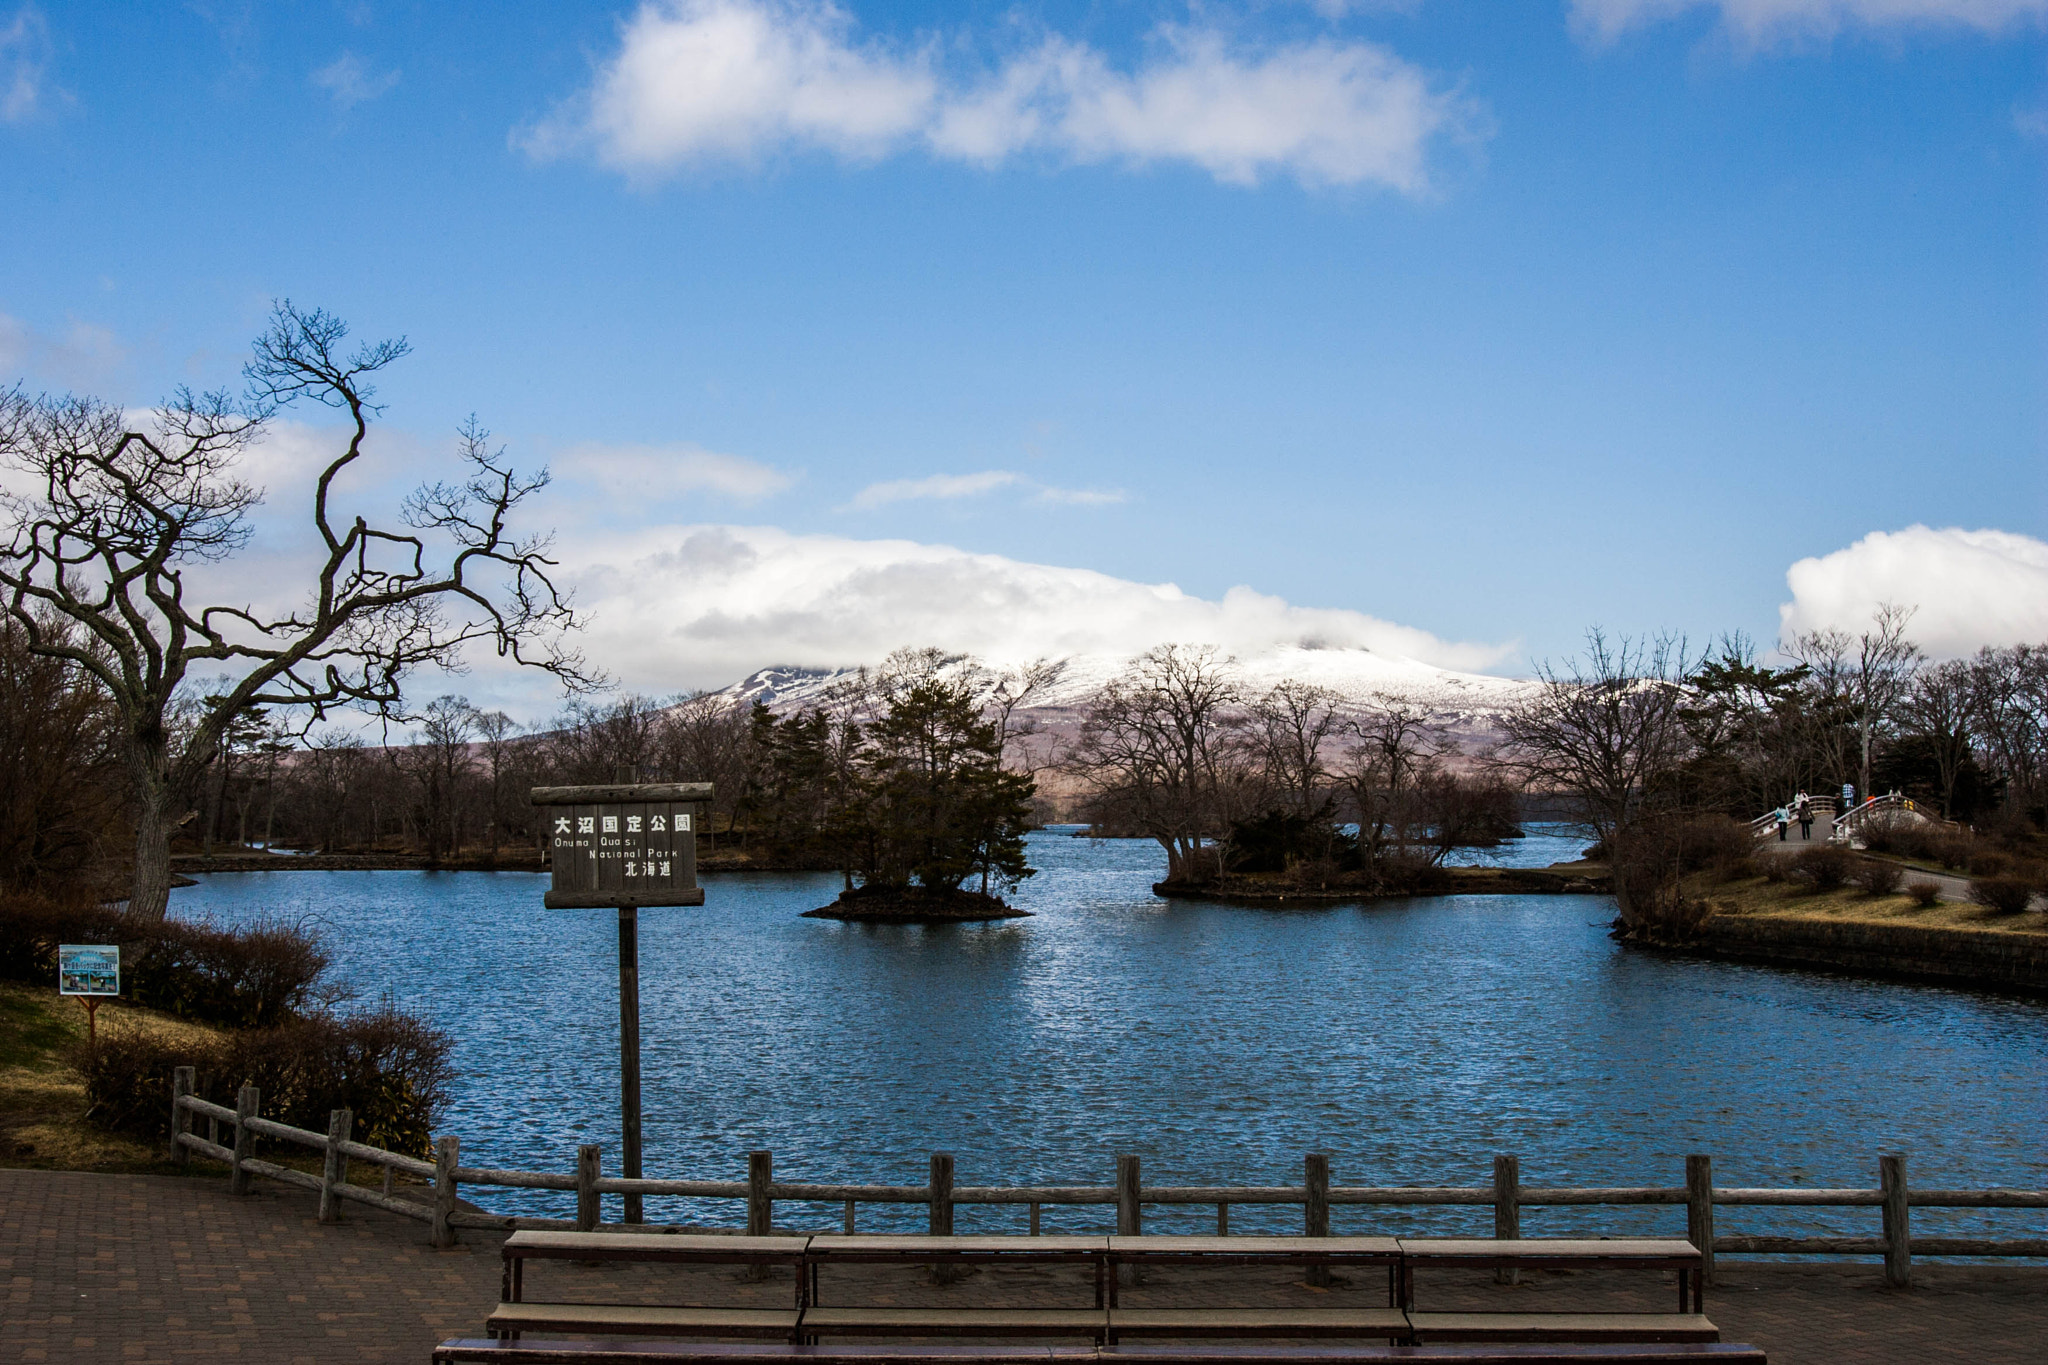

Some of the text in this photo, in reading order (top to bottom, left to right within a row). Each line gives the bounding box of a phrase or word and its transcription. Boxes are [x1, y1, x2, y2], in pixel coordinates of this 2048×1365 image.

[554, 813, 691, 834] 大沼国定公園
[554, 836, 636, 847] Onuma Quasi
[589, 848, 678, 859] National Park
[625, 861, 671, 877] 北海道
